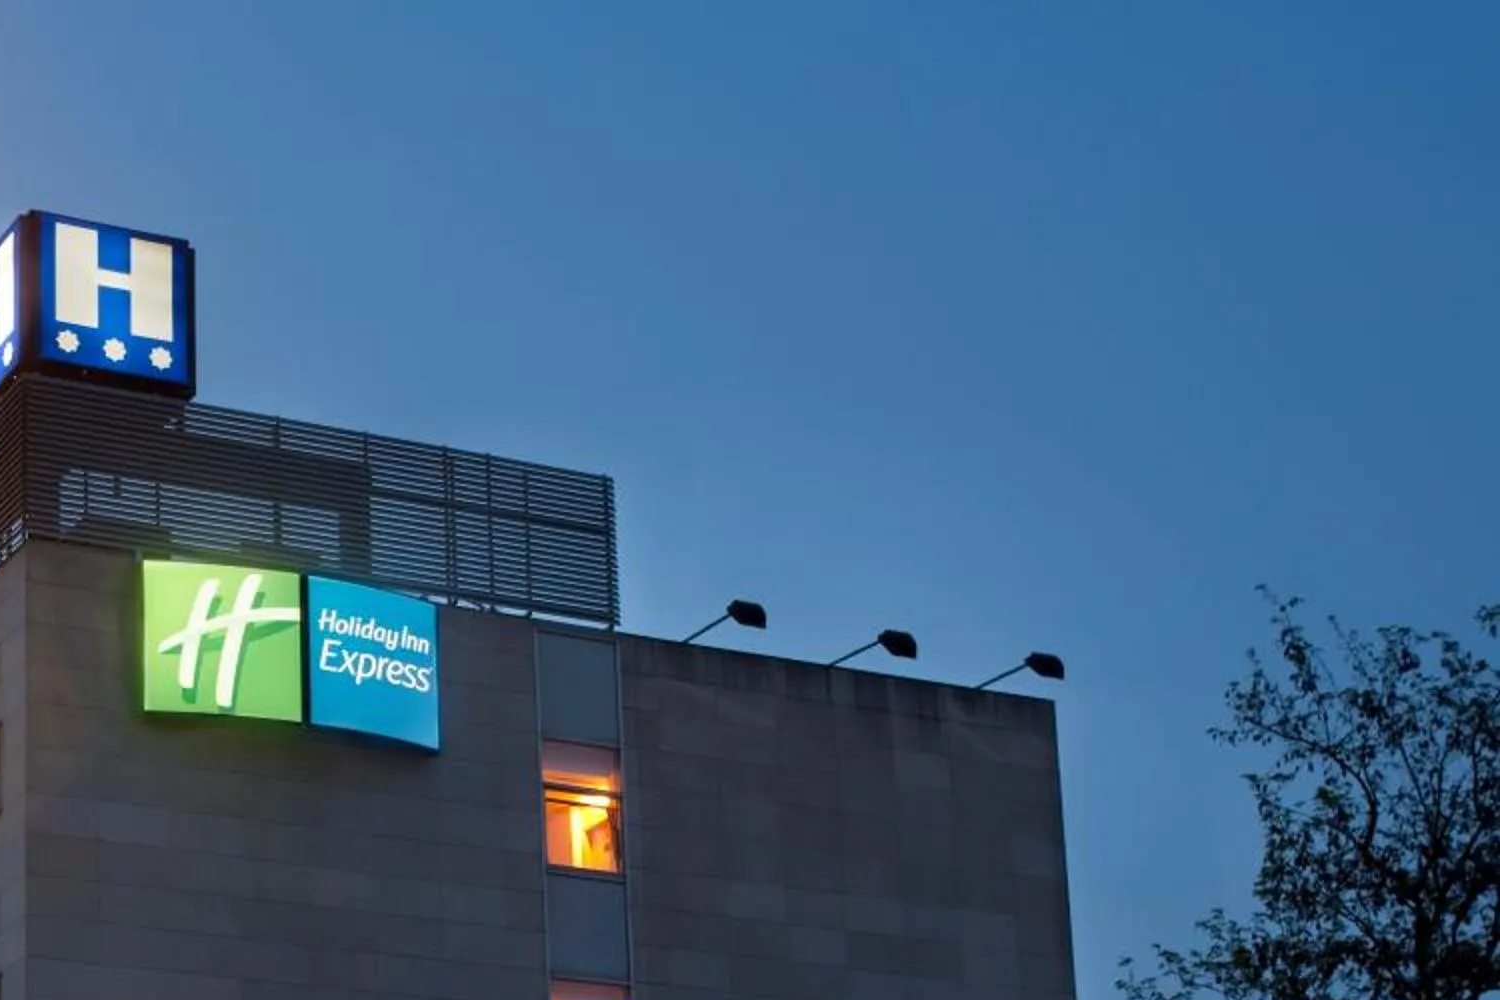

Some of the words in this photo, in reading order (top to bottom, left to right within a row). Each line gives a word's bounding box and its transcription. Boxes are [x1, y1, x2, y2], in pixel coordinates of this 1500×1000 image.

[55, 221, 173, 342] H
[318, 607, 401, 650] Holiday
[402, 625, 431, 655] Inn
[319, 638, 432, 692] Express
